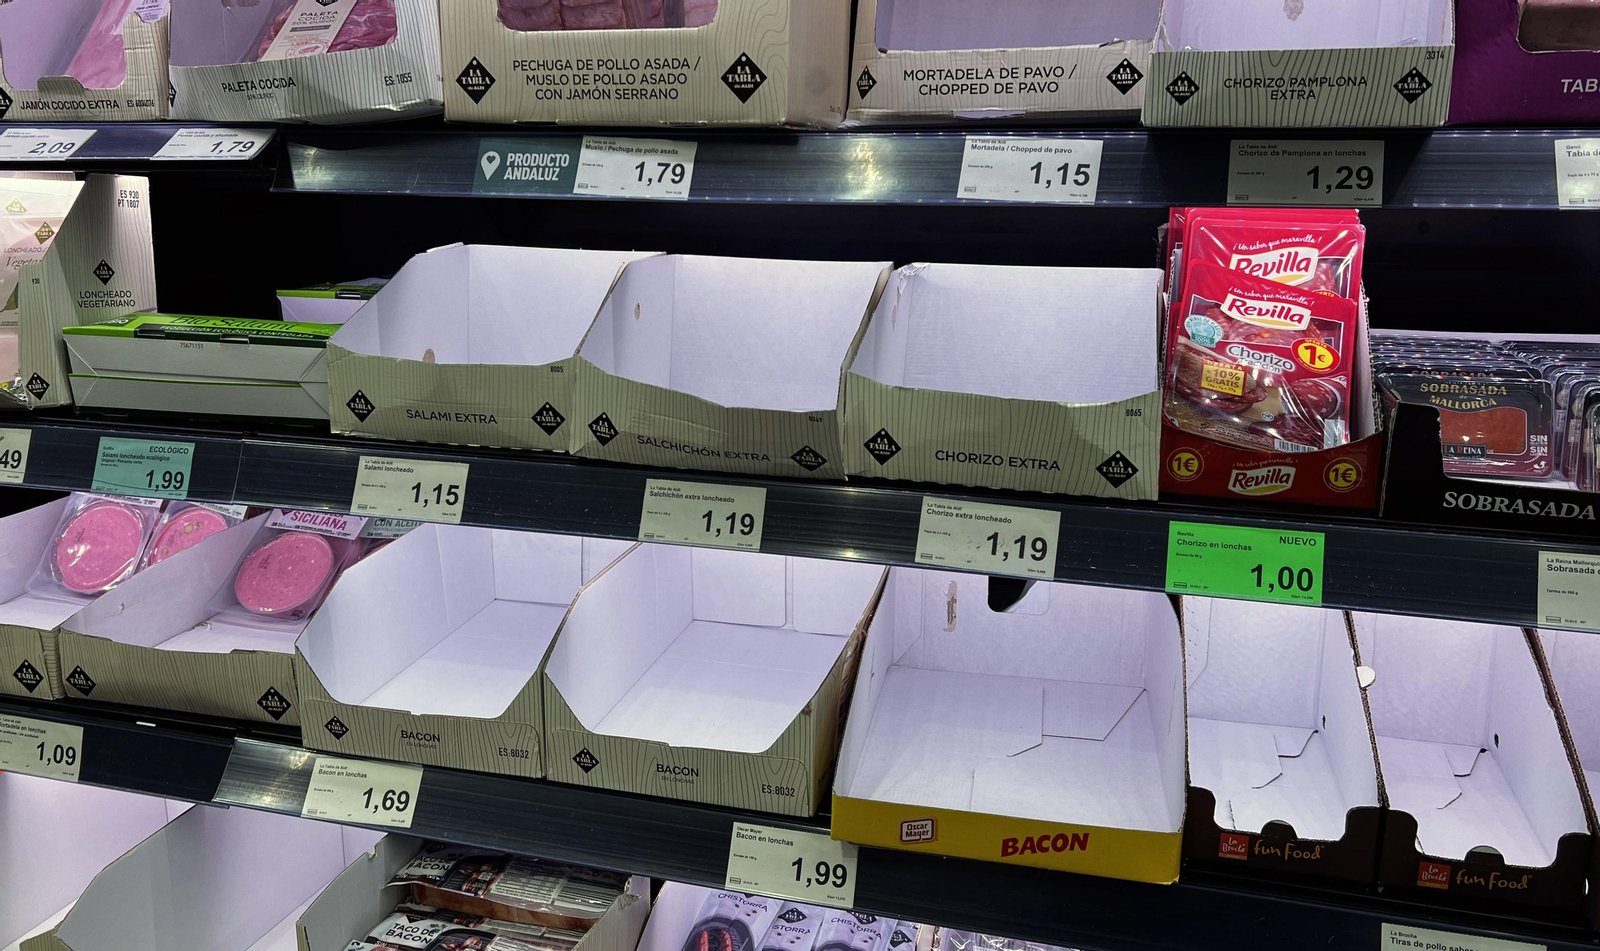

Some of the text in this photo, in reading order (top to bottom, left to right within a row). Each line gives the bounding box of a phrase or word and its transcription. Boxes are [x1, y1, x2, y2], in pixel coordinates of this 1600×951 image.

[513, 55, 701, 71] PECHUGA DE POLLO ASADA /
[1426, 51, 1445, 60] 3314
[469, 68, 481, 76] LA
[737, 65, 750, 74] LA
[903, 64, 1077, 81] MORTADELA DE PAVO /
[221, 76, 297, 93] PALETA COCIDA
[396, 72, 413, 84] 1055
[461, 76, 491, 84] TABLA
[526, 73, 687, 86] MUSLO DE POLLO ASADO
[726, 74, 761, 82] TABLA
[1224, 76, 1368, 89] CHORIZO PAMPLONA
[1560, 78, 1600, 93] TAB
[535, 85, 679, 100] CON JAMÓN SERRANO
[919, 81, 1059, 96] CHOPPED DE PAVO
[1270, 90, 1317, 100] EXTRA
[20, 99, 120, 110] JAMÓN COCIDO EXTRA
[28, 142, 76, 156] 2,09
[209, 140, 255, 155] 1,79
[585, 143, 603, 151] Muslo
[608, 145, 633, 154] Pechuga
[644, 147, 659, 156] pollo
[971, 144, 1005, 152] Mortadela
[1011, 145, 1043, 154] Chopped
[1238, 149, 1269, 157] Chorizo
[1282, 150, 1321, 158] Pamplona
[1334, 149, 1367, 157] lonchas
[1566, 150, 1591, 158] Tabla
[506, 152, 570, 167] PRODUCTO
[504, 167, 560, 181] ANDALUZ
[634, 161, 686, 187] 1,79
[1030, 161, 1091, 189] 1,15
[1306, 165, 1374, 194] 1,29
[120, 190, 139, 199] ES 930
[118, 199, 125, 208] PT
[1234, 250, 1312, 277] Revilla
[80, 290, 132, 299] LONCHEADO
[77, 299, 136, 309] VEGETARIANO
[1227, 299, 1305, 325] Revilla
[1228, 345, 1294, 371] Chorizo
[1205, 376, 1240, 389] GRATIS
[1420, 382, 1507, 396] SOBRASADA
[1430, 394, 1498, 410] MALLORCA
[406, 409, 498, 425] SALAMI EXTRA
[1125, 408, 1142, 417] 8065
[1529, 434, 1548, 442] SIN
[149, 445, 189, 455] ECOLÓGICO
[637, 434, 771, 462] SALCHICHÓN EXTRA
[1456, 445, 1482, 455] REINA
[1529, 446, 1548, 454] SIN
[101, 451, 119, 459] Salami
[119, 452, 146, 460] loncheado
[146, 454, 171, 462] ecológico
[935, 449, 1061, 472] CHORIZO EXTRA
[384, 466, 414, 474] loncheado
[1173, 456, 1196, 473] 1€
[145, 469, 185, 493] 1,99
[1231, 467, 1292, 490] Revilla
[1330, 466, 1354, 483] 1€
[411, 481, 460, 508] 1,15
[649, 490, 684, 499] Salchichón
[701, 494, 735, 503] loncheado
[1442, 491, 1597, 521] SOBRASADA
[290, 511, 348, 531] SICILIANA
[702, 509, 755, 538] 1,19
[926, 508, 1012, 524] Chorizo extra loncheado
[986, 531, 1048, 562] 1,19
[1176, 538, 1208, 548] Chorizo
[1221, 541, 1252, 552] lonchas
[1279, 536, 1317, 547] NUEVO
[1546, 563, 1595, 575] Sobrasada
[1250, 563, 1314, 593] 1,00
[401, 729, 441, 743] BACON
[36, 741, 77, 766] 1,09
[498, 747, 530, 760] ES:8032
[318, 768, 337, 776] Bacon
[345, 771, 368, 779] lonchas
[656, 763, 700, 778] BACON
[761, 783, 796, 798] ES:8032
[363, 787, 410, 814] 1,69
[905, 829, 930, 838] Mayer
[906, 822, 928, 831] Oscar
[736, 831, 757, 841] Bacon
[768, 836, 794, 847] lonchas
[1000, 832, 1090, 858] BACON
[1253, 840, 1322, 860] fun Food
[791, 857, 848, 889] 1,99
[1455, 870, 1528, 890] fun Food
[717, 892, 769, 913] CHISTORRA
[392, 922, 438, 938] TACO DE
[830, 916, 882, 940] CHISTORRA
[385, 929, 433, 945] BACON
[1390, 936, 1447, 951] Tiras de pollo
